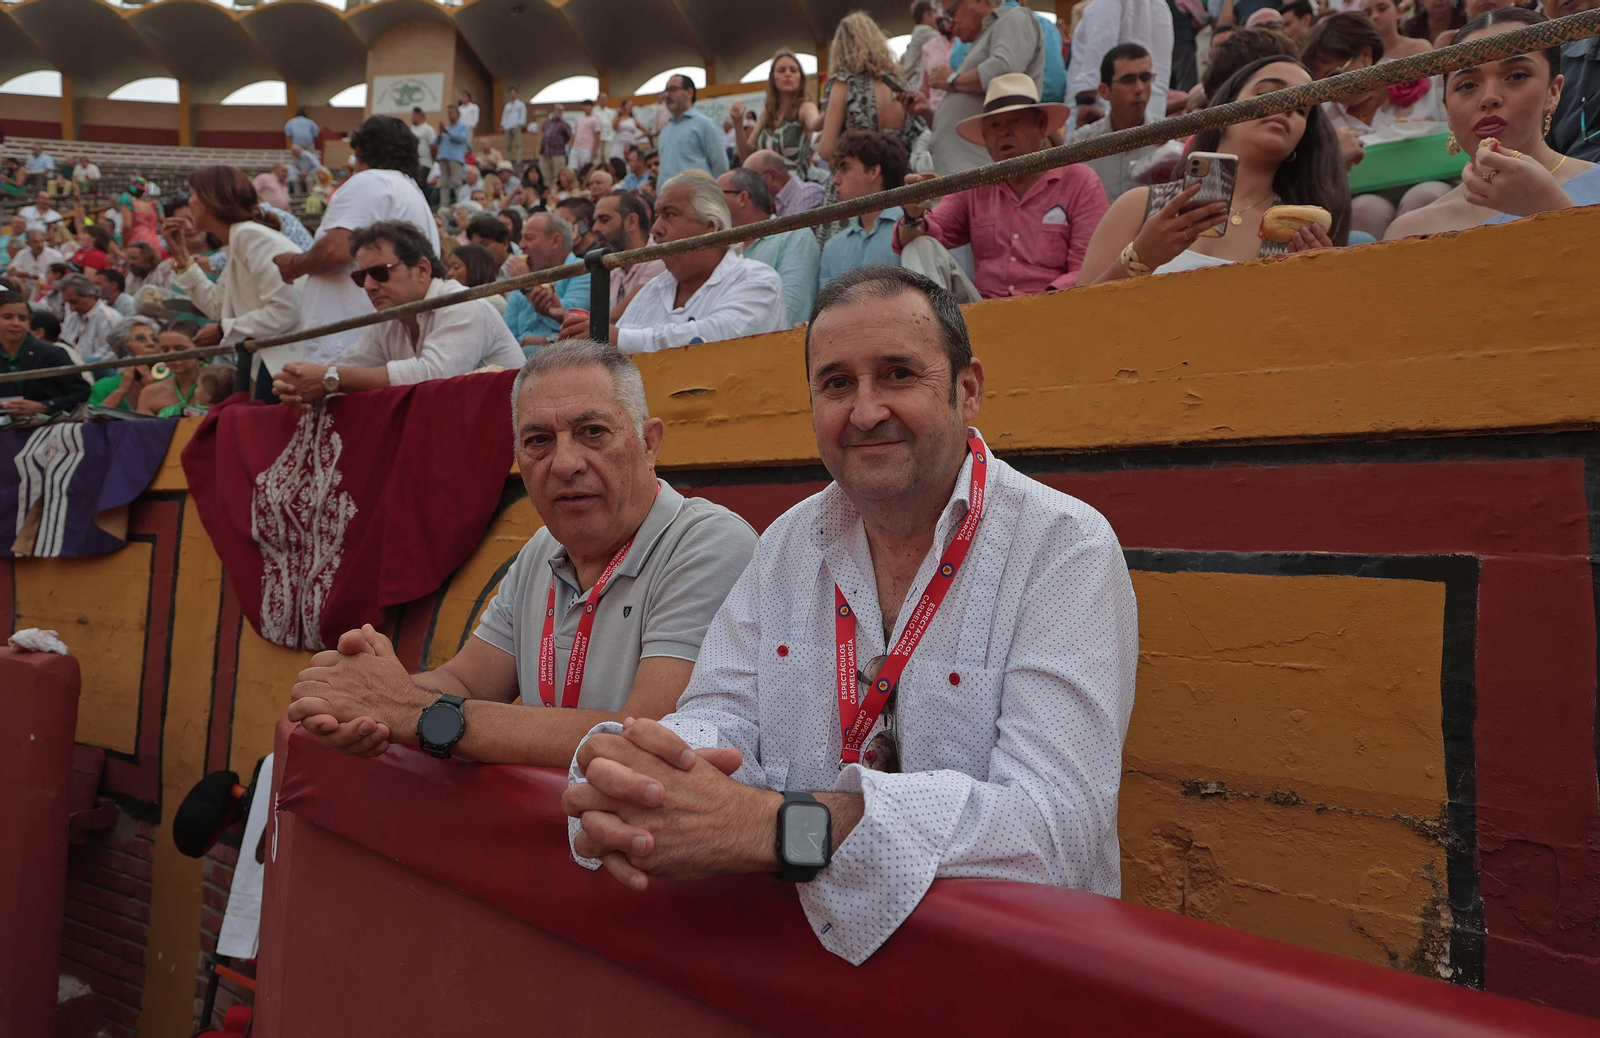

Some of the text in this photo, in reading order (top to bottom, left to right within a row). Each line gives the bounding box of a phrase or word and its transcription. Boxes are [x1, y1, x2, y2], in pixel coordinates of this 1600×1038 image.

[956, 480, 979, 541] CARMELO GARCÍA
[964, 487, 983, 541] ESPECTÁCULOS
[893, 594, 930, 655] CARMELO GARCÍA
[902, 602, 936, 656] ESPECTÁCULOS
[566, 631, 582, 686] CARMELO GARCÍA
[574, 636, 588, 684] ESPECTÁCULOS
[839, 643, 848, 700] ESPECTÁCULOS
[846, 639, 857, 705] CARMELO GARCÍA
[847, 709, 867, 742] CARMELO
[852, 717, 873, 749] ESPECTÁC
